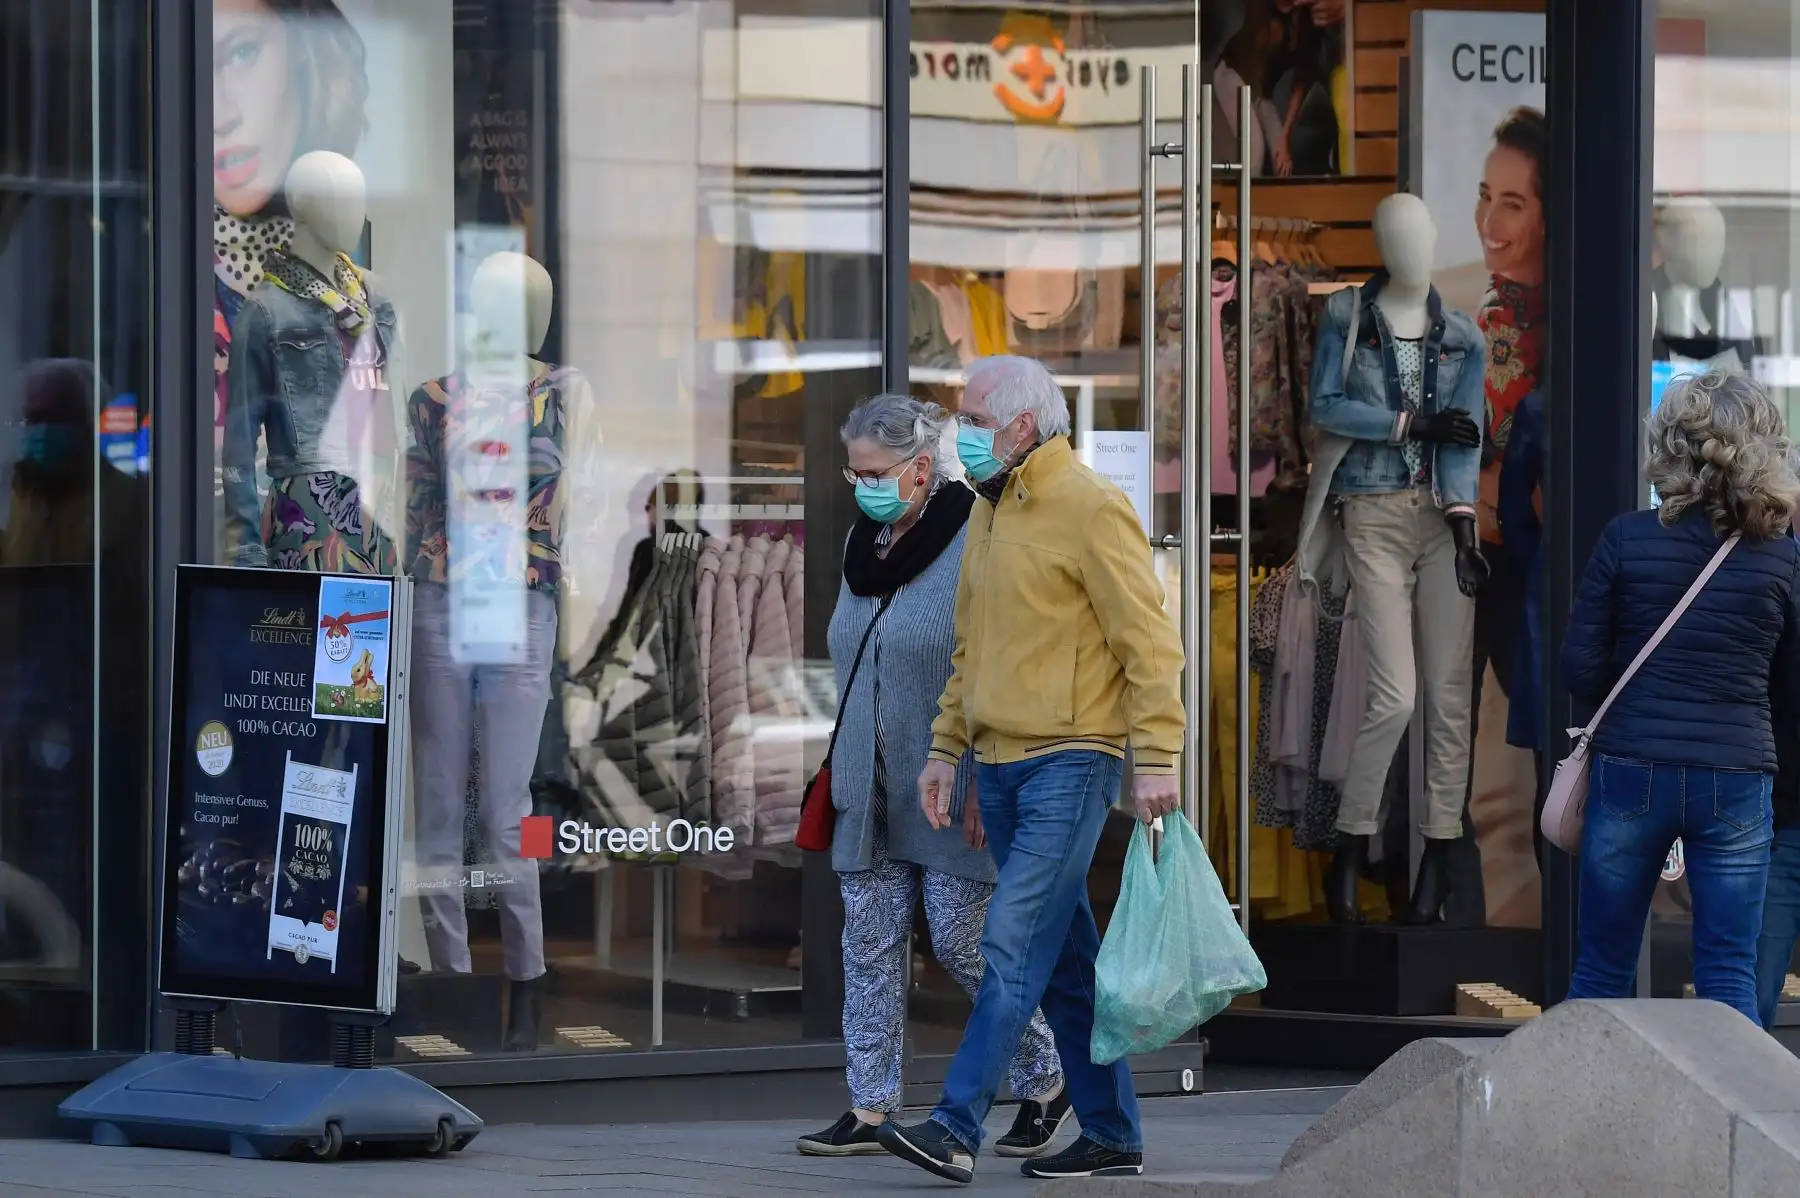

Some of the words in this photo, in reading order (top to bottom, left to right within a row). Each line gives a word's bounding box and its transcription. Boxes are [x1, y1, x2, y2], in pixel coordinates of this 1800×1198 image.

[469, 132, 528, 149] ALWAYS
[484, 153, 528, 171] GOOD
[1096, 442, 1118, 454] Street
[1120, 442, 1137, 454] One
[260, 607, 297, 626] Lindt
[250, 629, 312, 646] EXCELLENCE
[250, 670, 271, 687] DIE
[273, 671, 307, 688] NEUE
[224, 693, 258, 710] LINDT
[236, 718, 269, 735] 100%
[272, 720, 317, 738] CACAO
[200, 730, 228, 749] NEU
[194, 792, 235, 807] Intensiver
[236, 794, 270, 810] Genuss,
[194, 811, 220, 824] Cacao
[221, 812, 239, 828] pur!
[294, 823, 333, 853] 100%
[558, 818, 661, 854] Street
[665, 818, 735, 854] One
[295, 849, 328, 863] CACAO
[287, 931, 306, 942] CACAO
[306, 934, 318, 945] PUR
